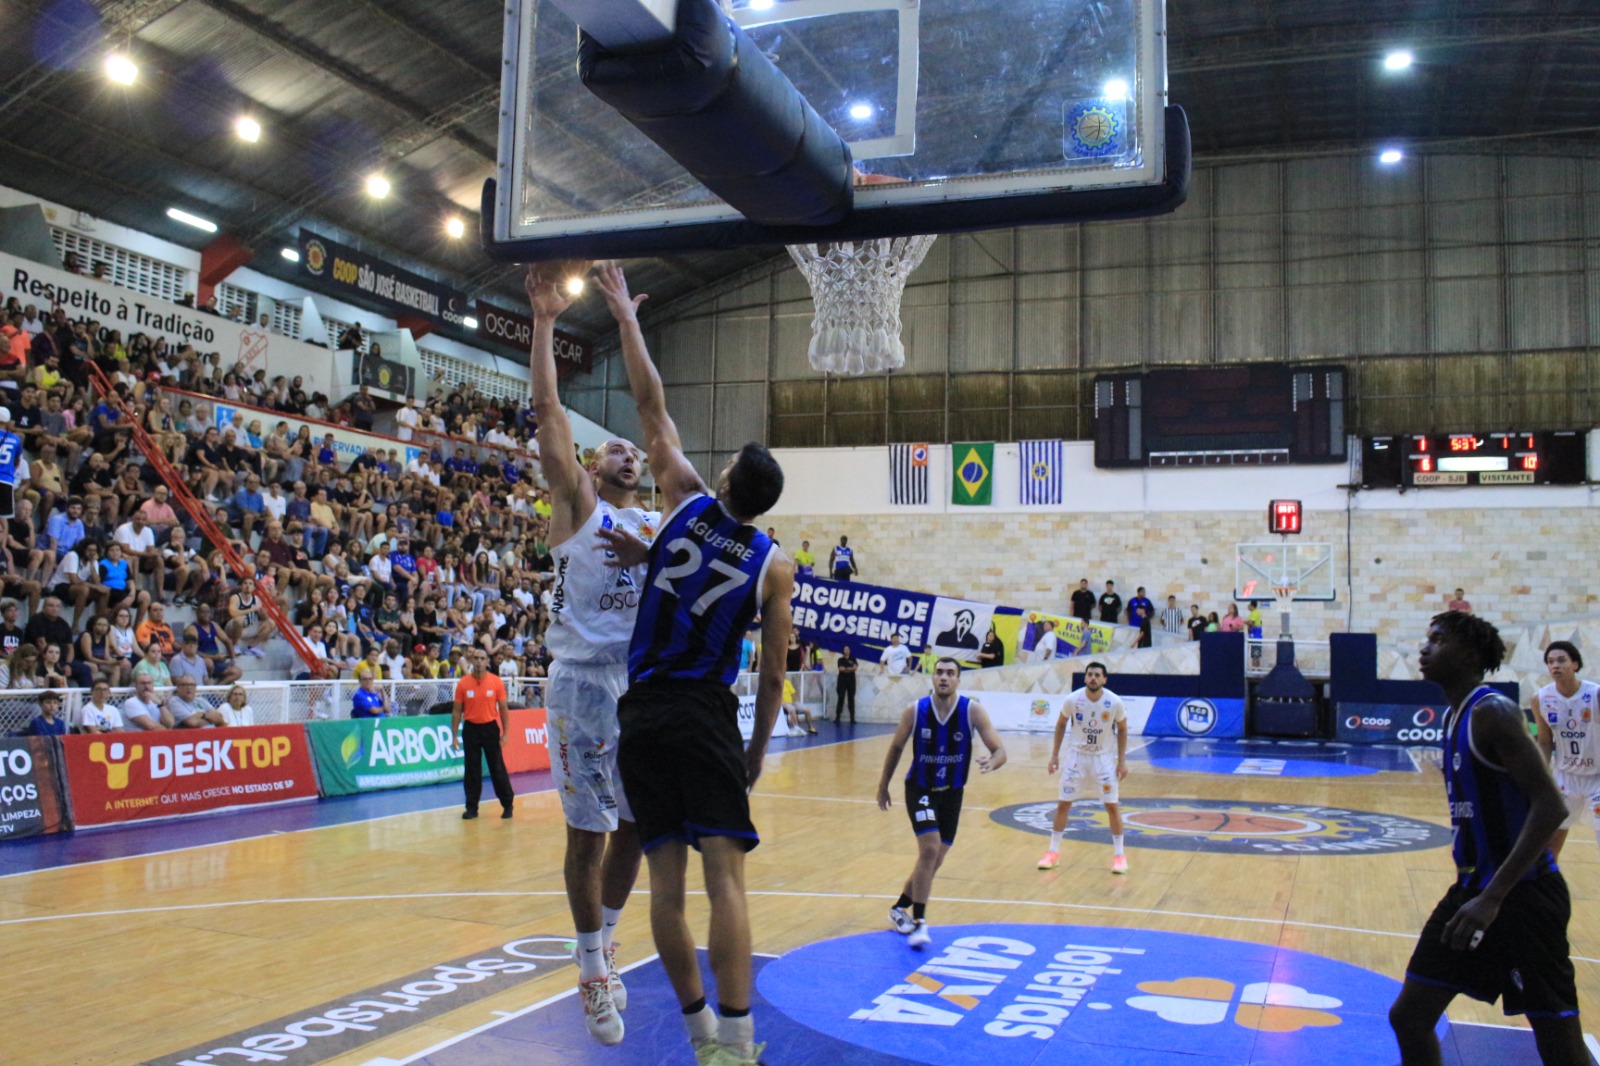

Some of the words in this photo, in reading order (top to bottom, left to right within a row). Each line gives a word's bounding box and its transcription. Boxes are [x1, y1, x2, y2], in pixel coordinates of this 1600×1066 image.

[333, 257, 358, 284] COOP
[358, 264, 375, 292] SÃO
[375, 274, 395, 299] JOSÉ
[395, 280, 439, 316] BASKETBALL
[13, 268, 111, 316] Respeito
[116, 297, 128, 320] à
[135, 303, 215, 344] Tradição
[485, 313, 530, 345] OSCAR
[553, 337, 583, 363] SCAR
[1451, 437, 1477, 450] 5:37
[1523, 456, 1537, 469] 10
[1416, 475, 1441, 483] COOP
[1449, 475, 1465, 483] SJB
[1281, 515, 1298, 530] 11
[686, 517, 755, 562] AGUERRE
[654, 538, 750, 617] 27
[600, 590, 638, 611] OSC
[791, 581, 886, 614] ORGULHO
[897, 599, 930, 622] DE
[820, 612, 923, 647] JOSEENSE
[1065, 622, 1103, 639] RAPA
[1362, 717, 1391, 726] COOP
[1082, 727, 1103, 735] COOP
[1087, 734, 1097, 744] 91
[1561, 731, 1586, 739] COOP
[1570, 741, 1580, 755] 0
[150, 735, 291, 779] DESKTOP
[920, 753, 964, 764] PINHEIROS
[936, 766, 947, 779] 4
[105, 800, 113, 810] A
[114, 796, 159, 809] INTERNET
[161, 794, 178, 804] QUE
[181, 790, 202, 801] MAIS
[203, 786, 230, 798] CRESCE
[231, 785, 244, 795] NO
[245, 782, 273, 793] ESTADO
[273, 781, 284, 790] DE
[284, 780, 294, 789] SP
[919, 795, 930, 806] 4
[1, 808, 42, 822] LIMPEZA
[848, 936, 1037, 1026] CAIXA
[984, 944, 1146, 1040] loterias
